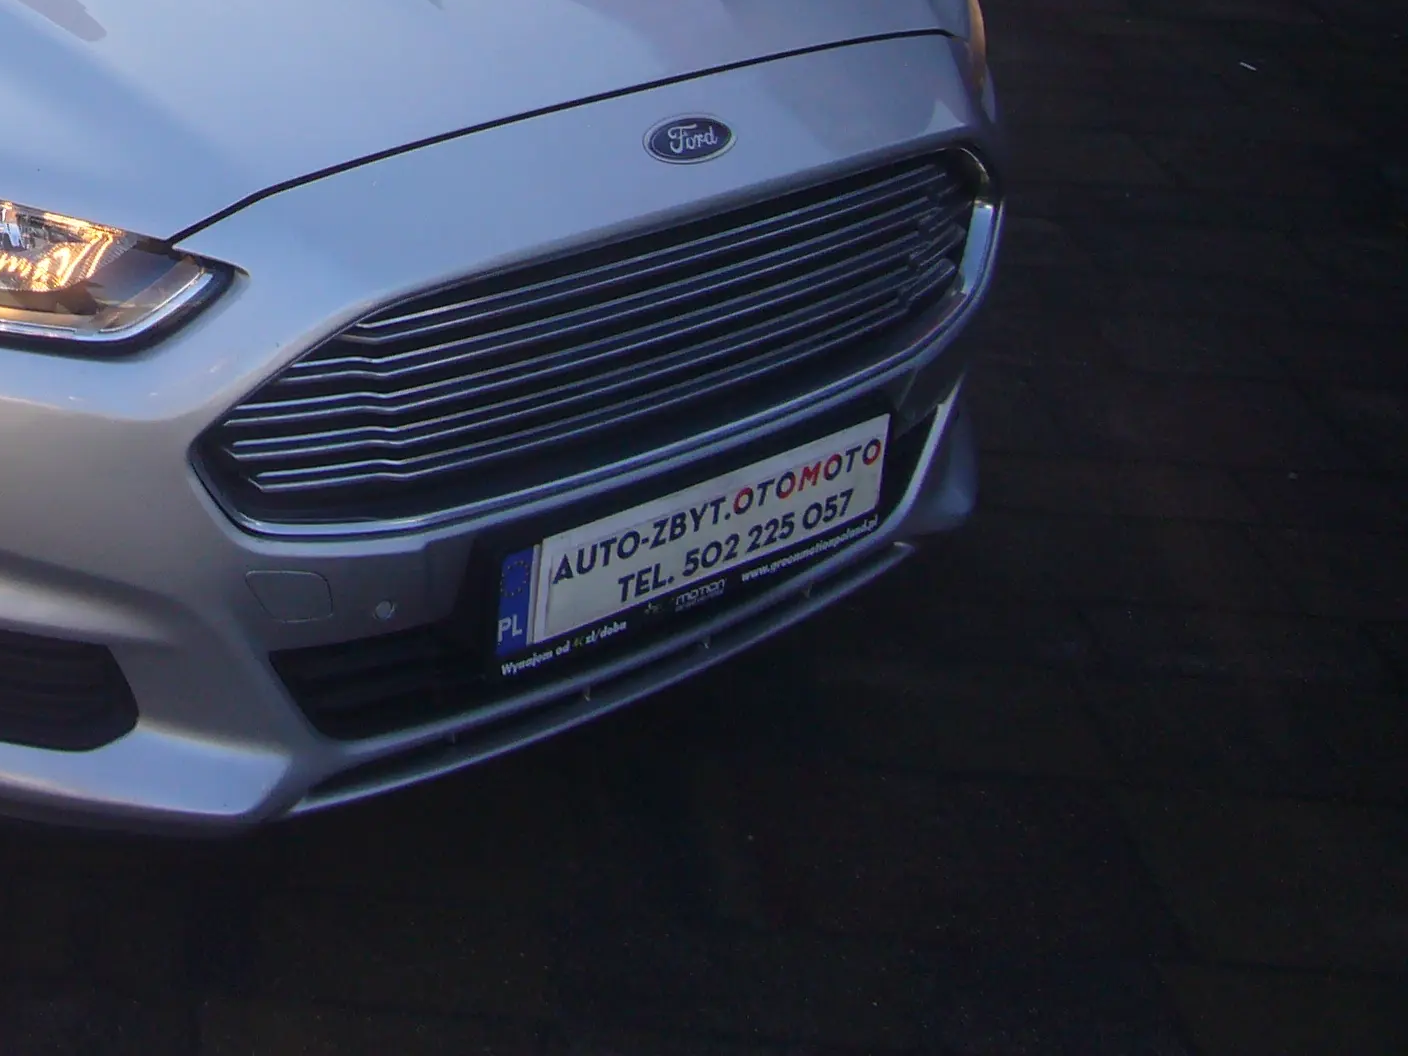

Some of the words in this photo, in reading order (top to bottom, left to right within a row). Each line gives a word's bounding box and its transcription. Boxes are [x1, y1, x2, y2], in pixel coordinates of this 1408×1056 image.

[668, 123, 718, 154] Ford
[552, 439, 882, 584] AUTO-ZBYT.OTOMOTO
[618, 562, 675, 603] TEL.
[682, 533, 740, 577] 502
[748, 511, 795, 553] 225
[802, 488, 854, 530] 057
[497, 614, 523, 643] PL
[555, 640, 571, 656] od
